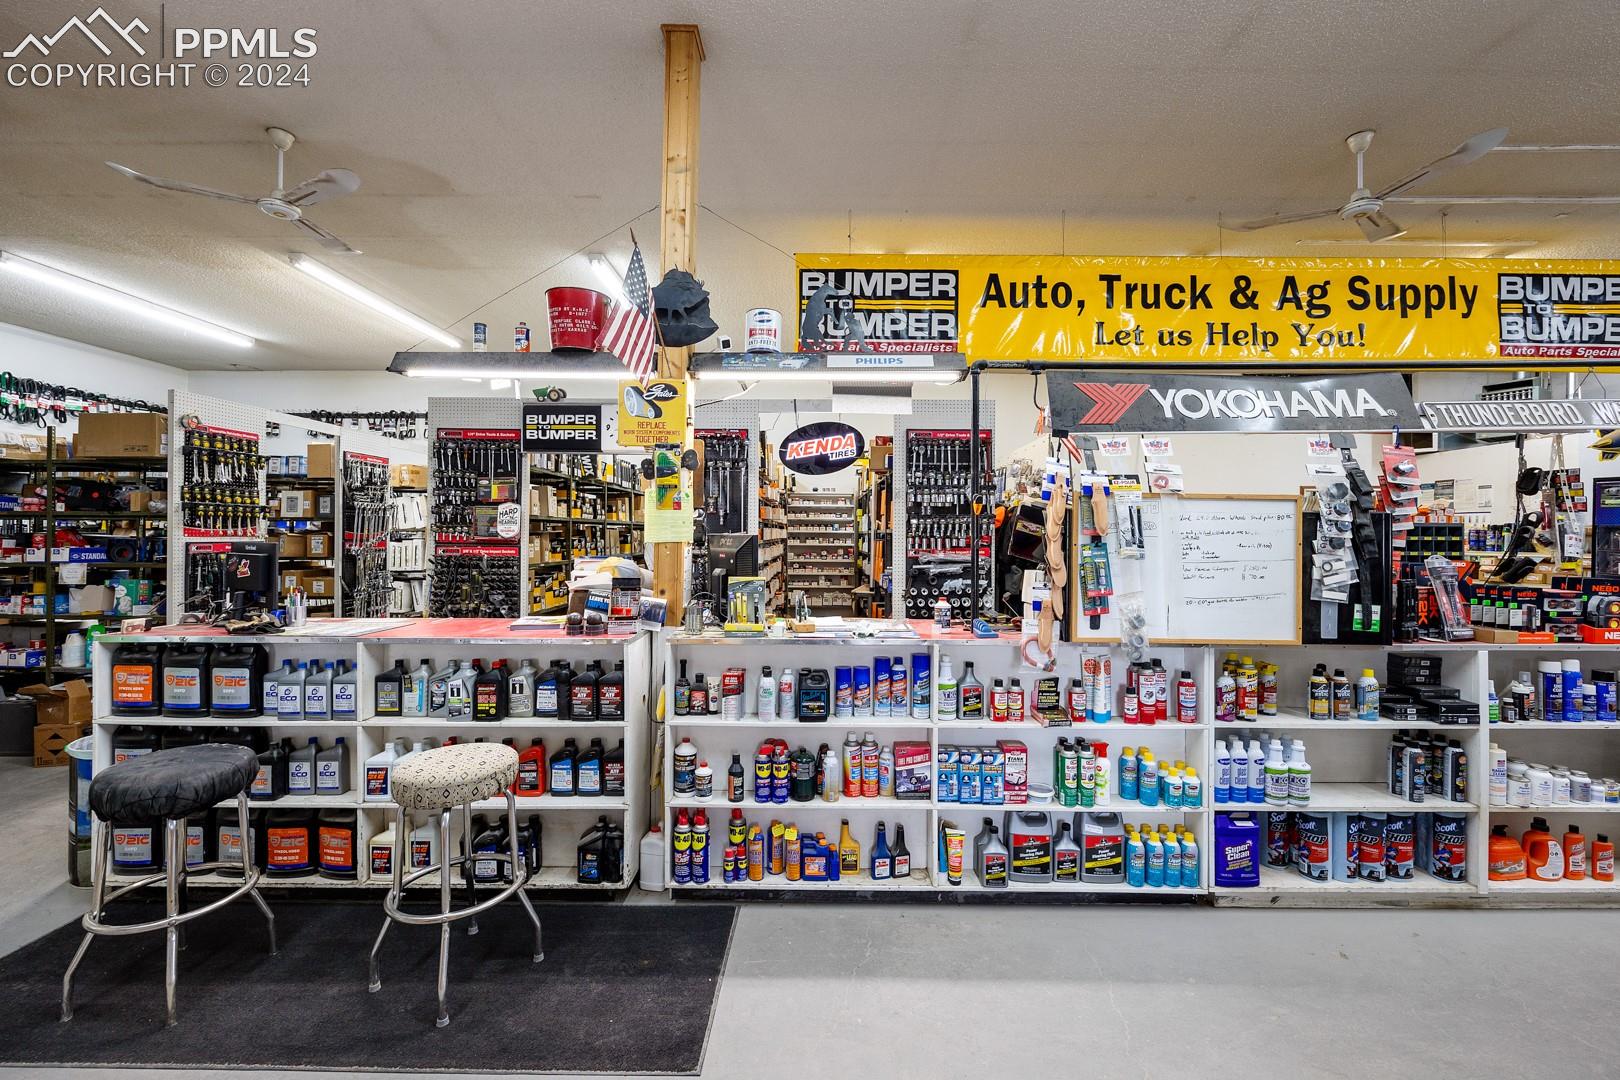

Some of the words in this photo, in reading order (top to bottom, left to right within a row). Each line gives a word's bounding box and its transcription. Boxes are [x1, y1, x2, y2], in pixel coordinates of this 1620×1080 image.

[801, 271, 956, 298] BUMPER
[981, 273, 1085, 317] Auto,
[1099, 274, 1212, 309] Truck
[1230, 275, 1258, 309] &
[1277, 275, 1331, 319] Ag
[1347, 275, 1479, 324] Supply
[826, 299, 854, 310] TO
[1522, 304, 1552, 314] TO
[1094, 321, 1144, 347] Let
[1158, 327, 1192, 346] us
[1206, 322, 1280, 351] Help
[1290, 322, 1366, 347] You!
[878, 342, 953, 353] Specialists
[1505, 346, 1536, 357] Auto
[1539, 347, 1572, 358] Parts
[855, 356, 904, 366] PHILIPS
[643, 384, 681, 400] Gates
[1149, 386, 1388, 419] YOKOHAMA
[526, 414, 597, 425] BUMPER
[1436, 402, 1585, 426] THUNDERBIRD
[637, 421, 667, 429] REPLACE
[525, 429, 597, 440] BUMPER
[635, 435, 669, 444] TOGETHER
[786, 432, 857, 462] KENDA
[829, 448, 856, 460] TIRES
[580, 456, 595, 475] WIX
[499, 508, 518, 518] HARD
[1418, 601, 1428, 624] 2K
[452, 688, 457, 697] 1
[514, 683, 519, 694] 1
[1298, 819, 1318, 831] Scott
[1434, 822, 1457, 832] Scott
[1225, 843, 1250, 855] Super
[1226, 850, 1250, 861] Clean
